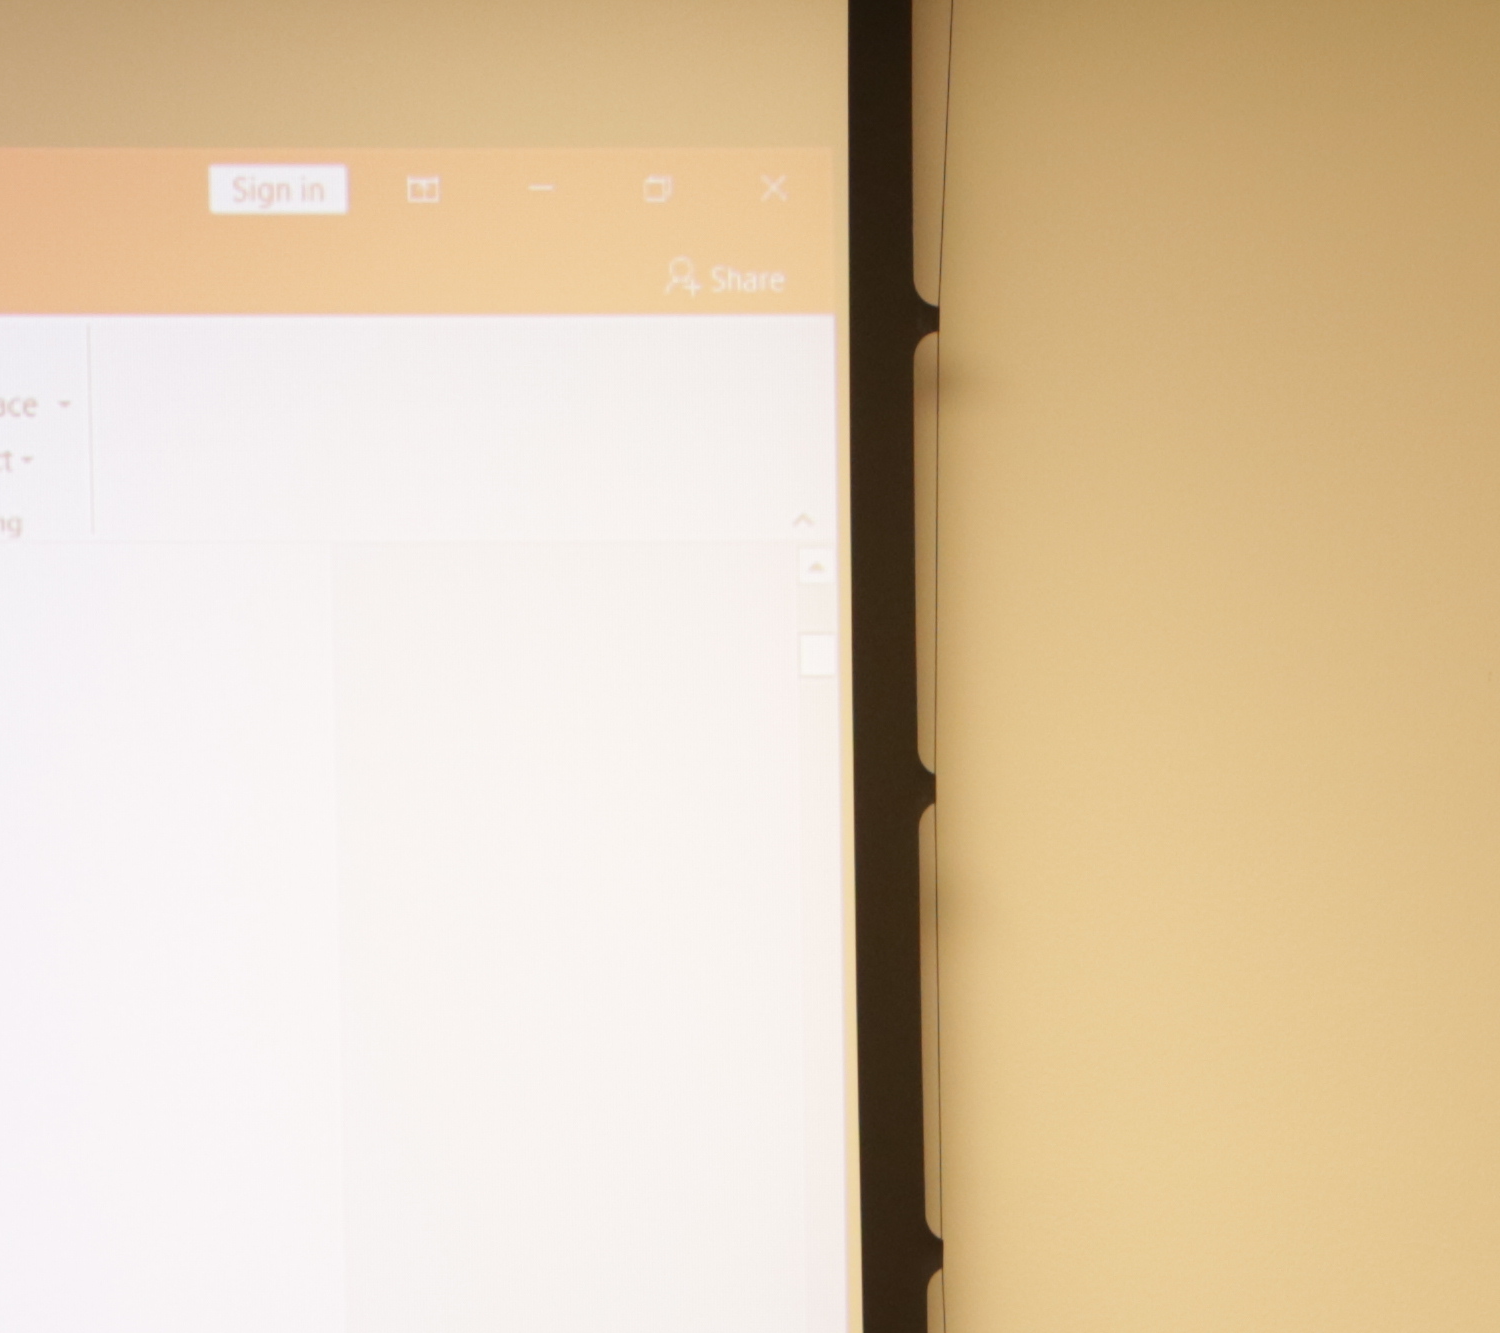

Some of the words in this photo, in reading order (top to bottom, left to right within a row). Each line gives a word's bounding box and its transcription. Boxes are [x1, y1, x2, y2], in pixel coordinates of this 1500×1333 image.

[232, 175, 290, 208] Sign
[301, 176, 325, 202] in
[712, 267, 784, 291] Share
